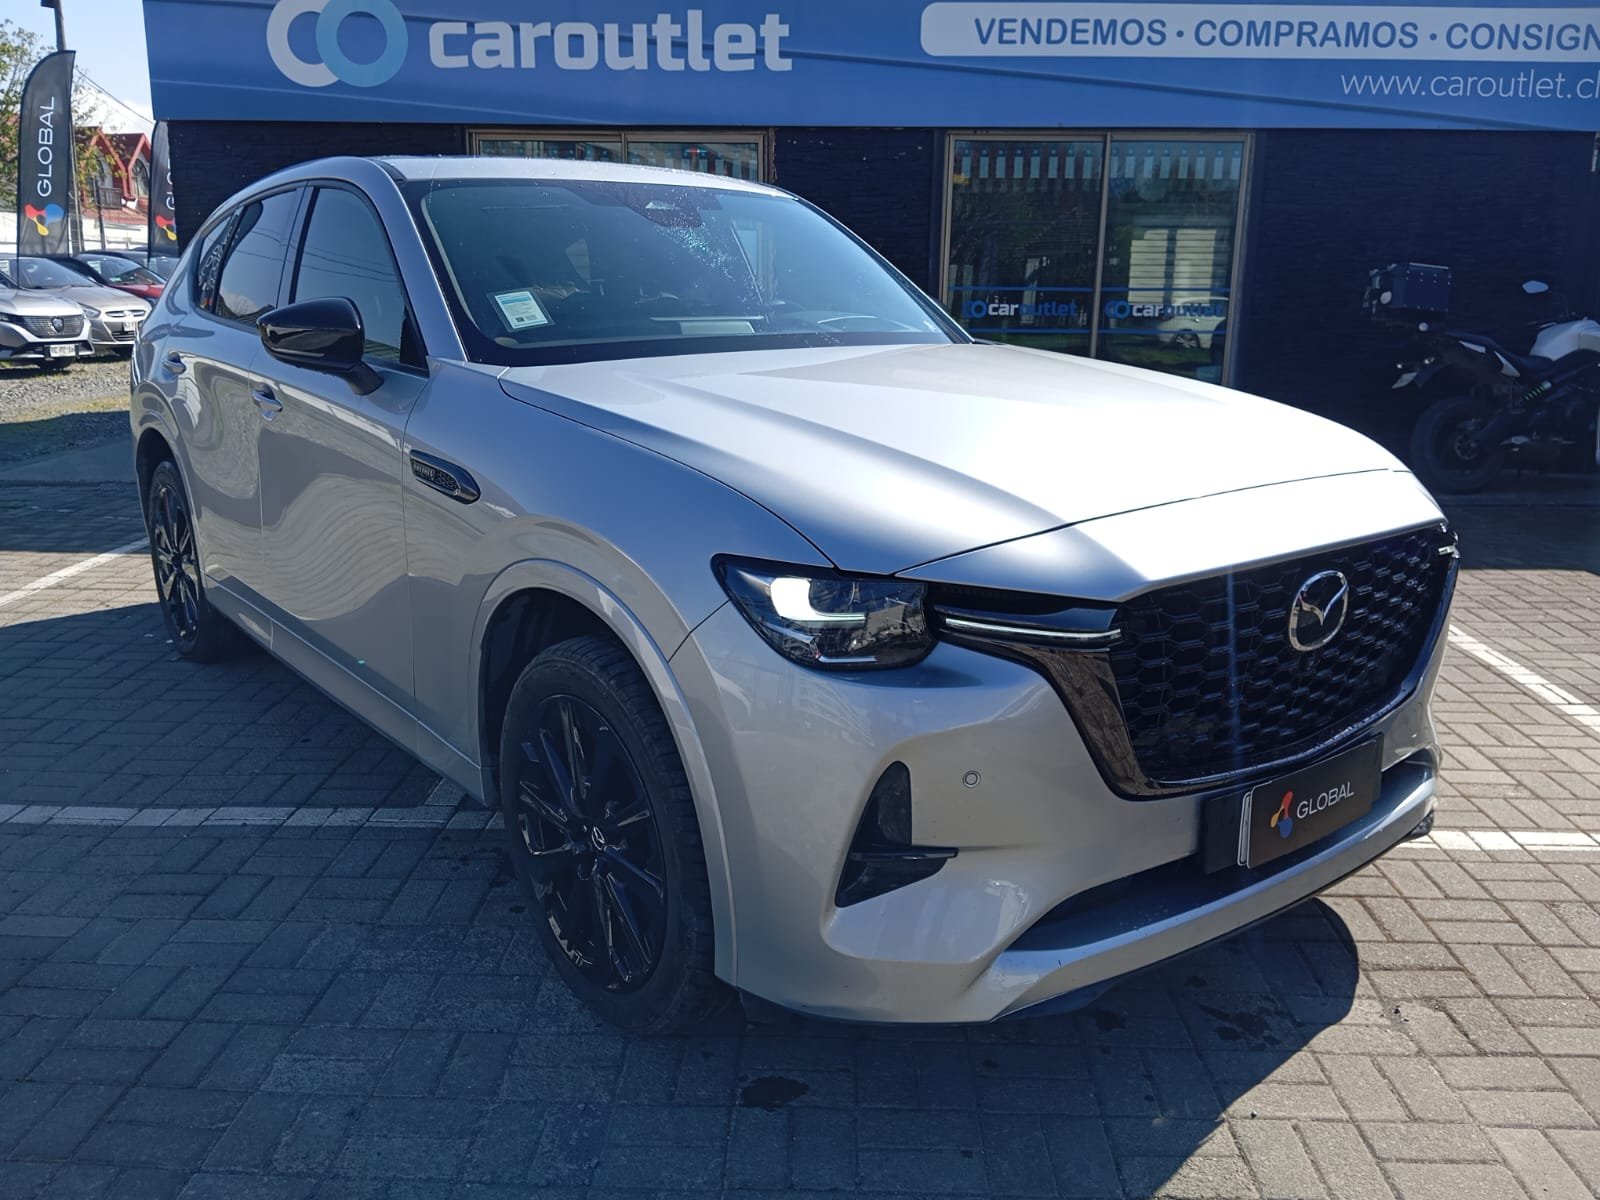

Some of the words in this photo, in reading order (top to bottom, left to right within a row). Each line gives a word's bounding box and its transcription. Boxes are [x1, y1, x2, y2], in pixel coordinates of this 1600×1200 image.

[429, 9, 793, 72] caroutlet
[975, 18, 1167, 46] VENDEMOS
[1195, 20, 1418, 49] COMPRAMOS
[37, 96, 55, 197] GLOBAL
[988, 300, 1078, 317] caroutlet
[1297, 781, 1355, 819] GLOBAL
